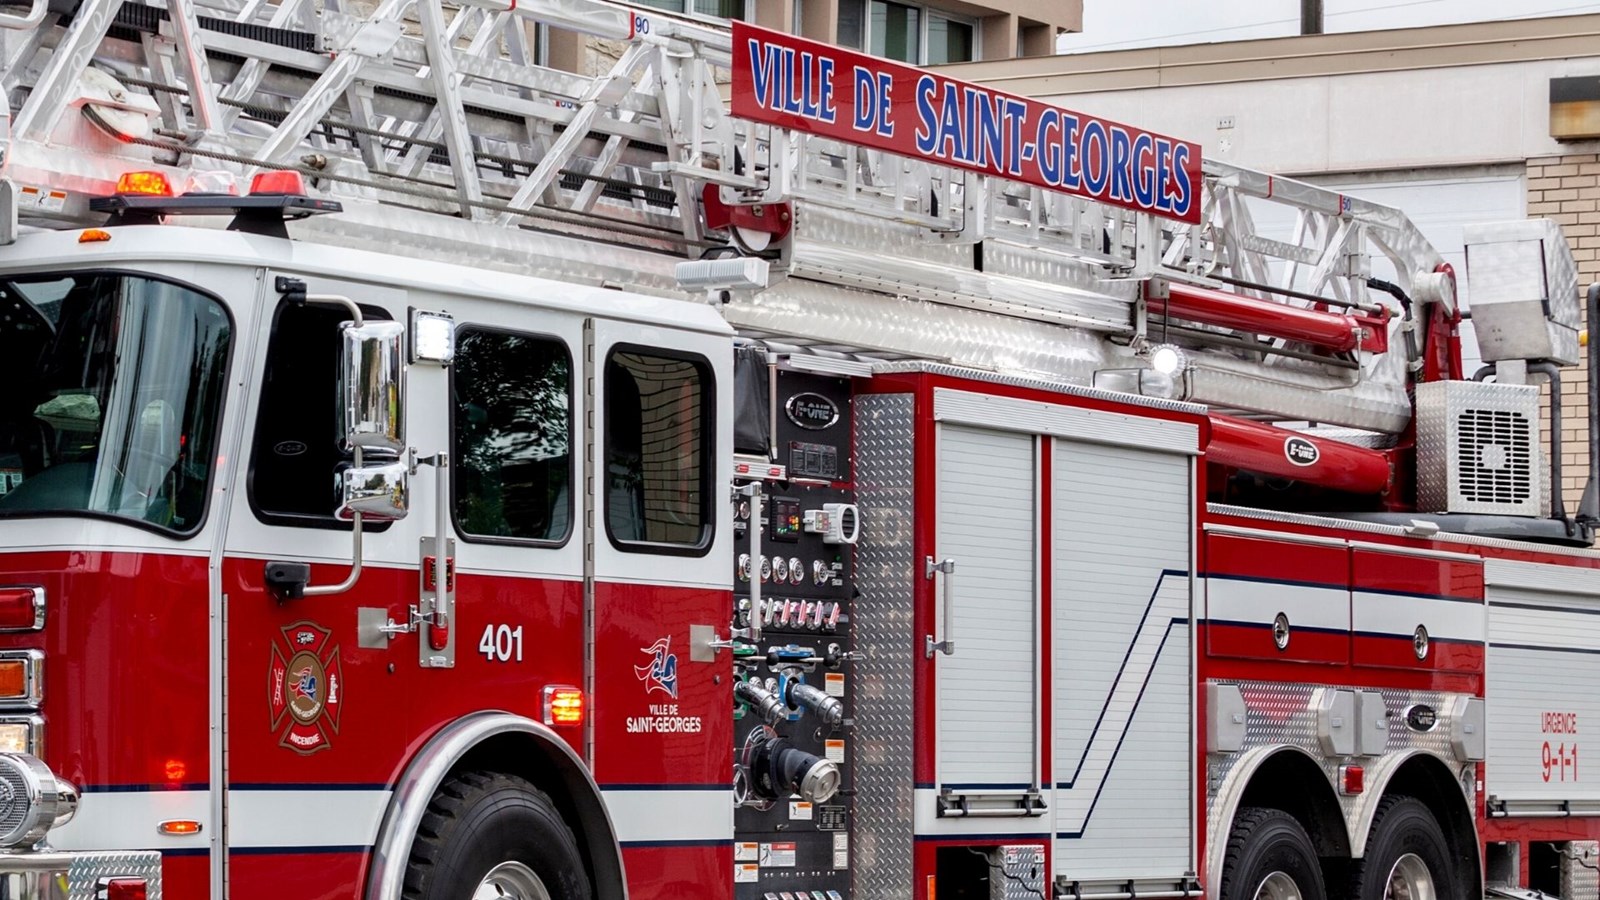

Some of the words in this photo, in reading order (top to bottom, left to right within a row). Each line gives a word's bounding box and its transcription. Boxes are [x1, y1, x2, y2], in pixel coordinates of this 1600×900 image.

[635, 16, 649, 34] 90
[748, 38, 836, 124] VILLE
[853, 66, 894, 138] DE
[915, 74, 1190, 216] SAINT-GEORGES
[479, 624, 522, 661] 401
[649, 704, 668, 715] VILLE
[669, 704, 678, 715] DE
[626, 717, 701, 733] SAINT-GEORGES
[1541, 712, 1577, 733] URGENCE
[290, 732, 320, 746] INCENDIE
[1542, 741, 1577, 783] 9-1-1
